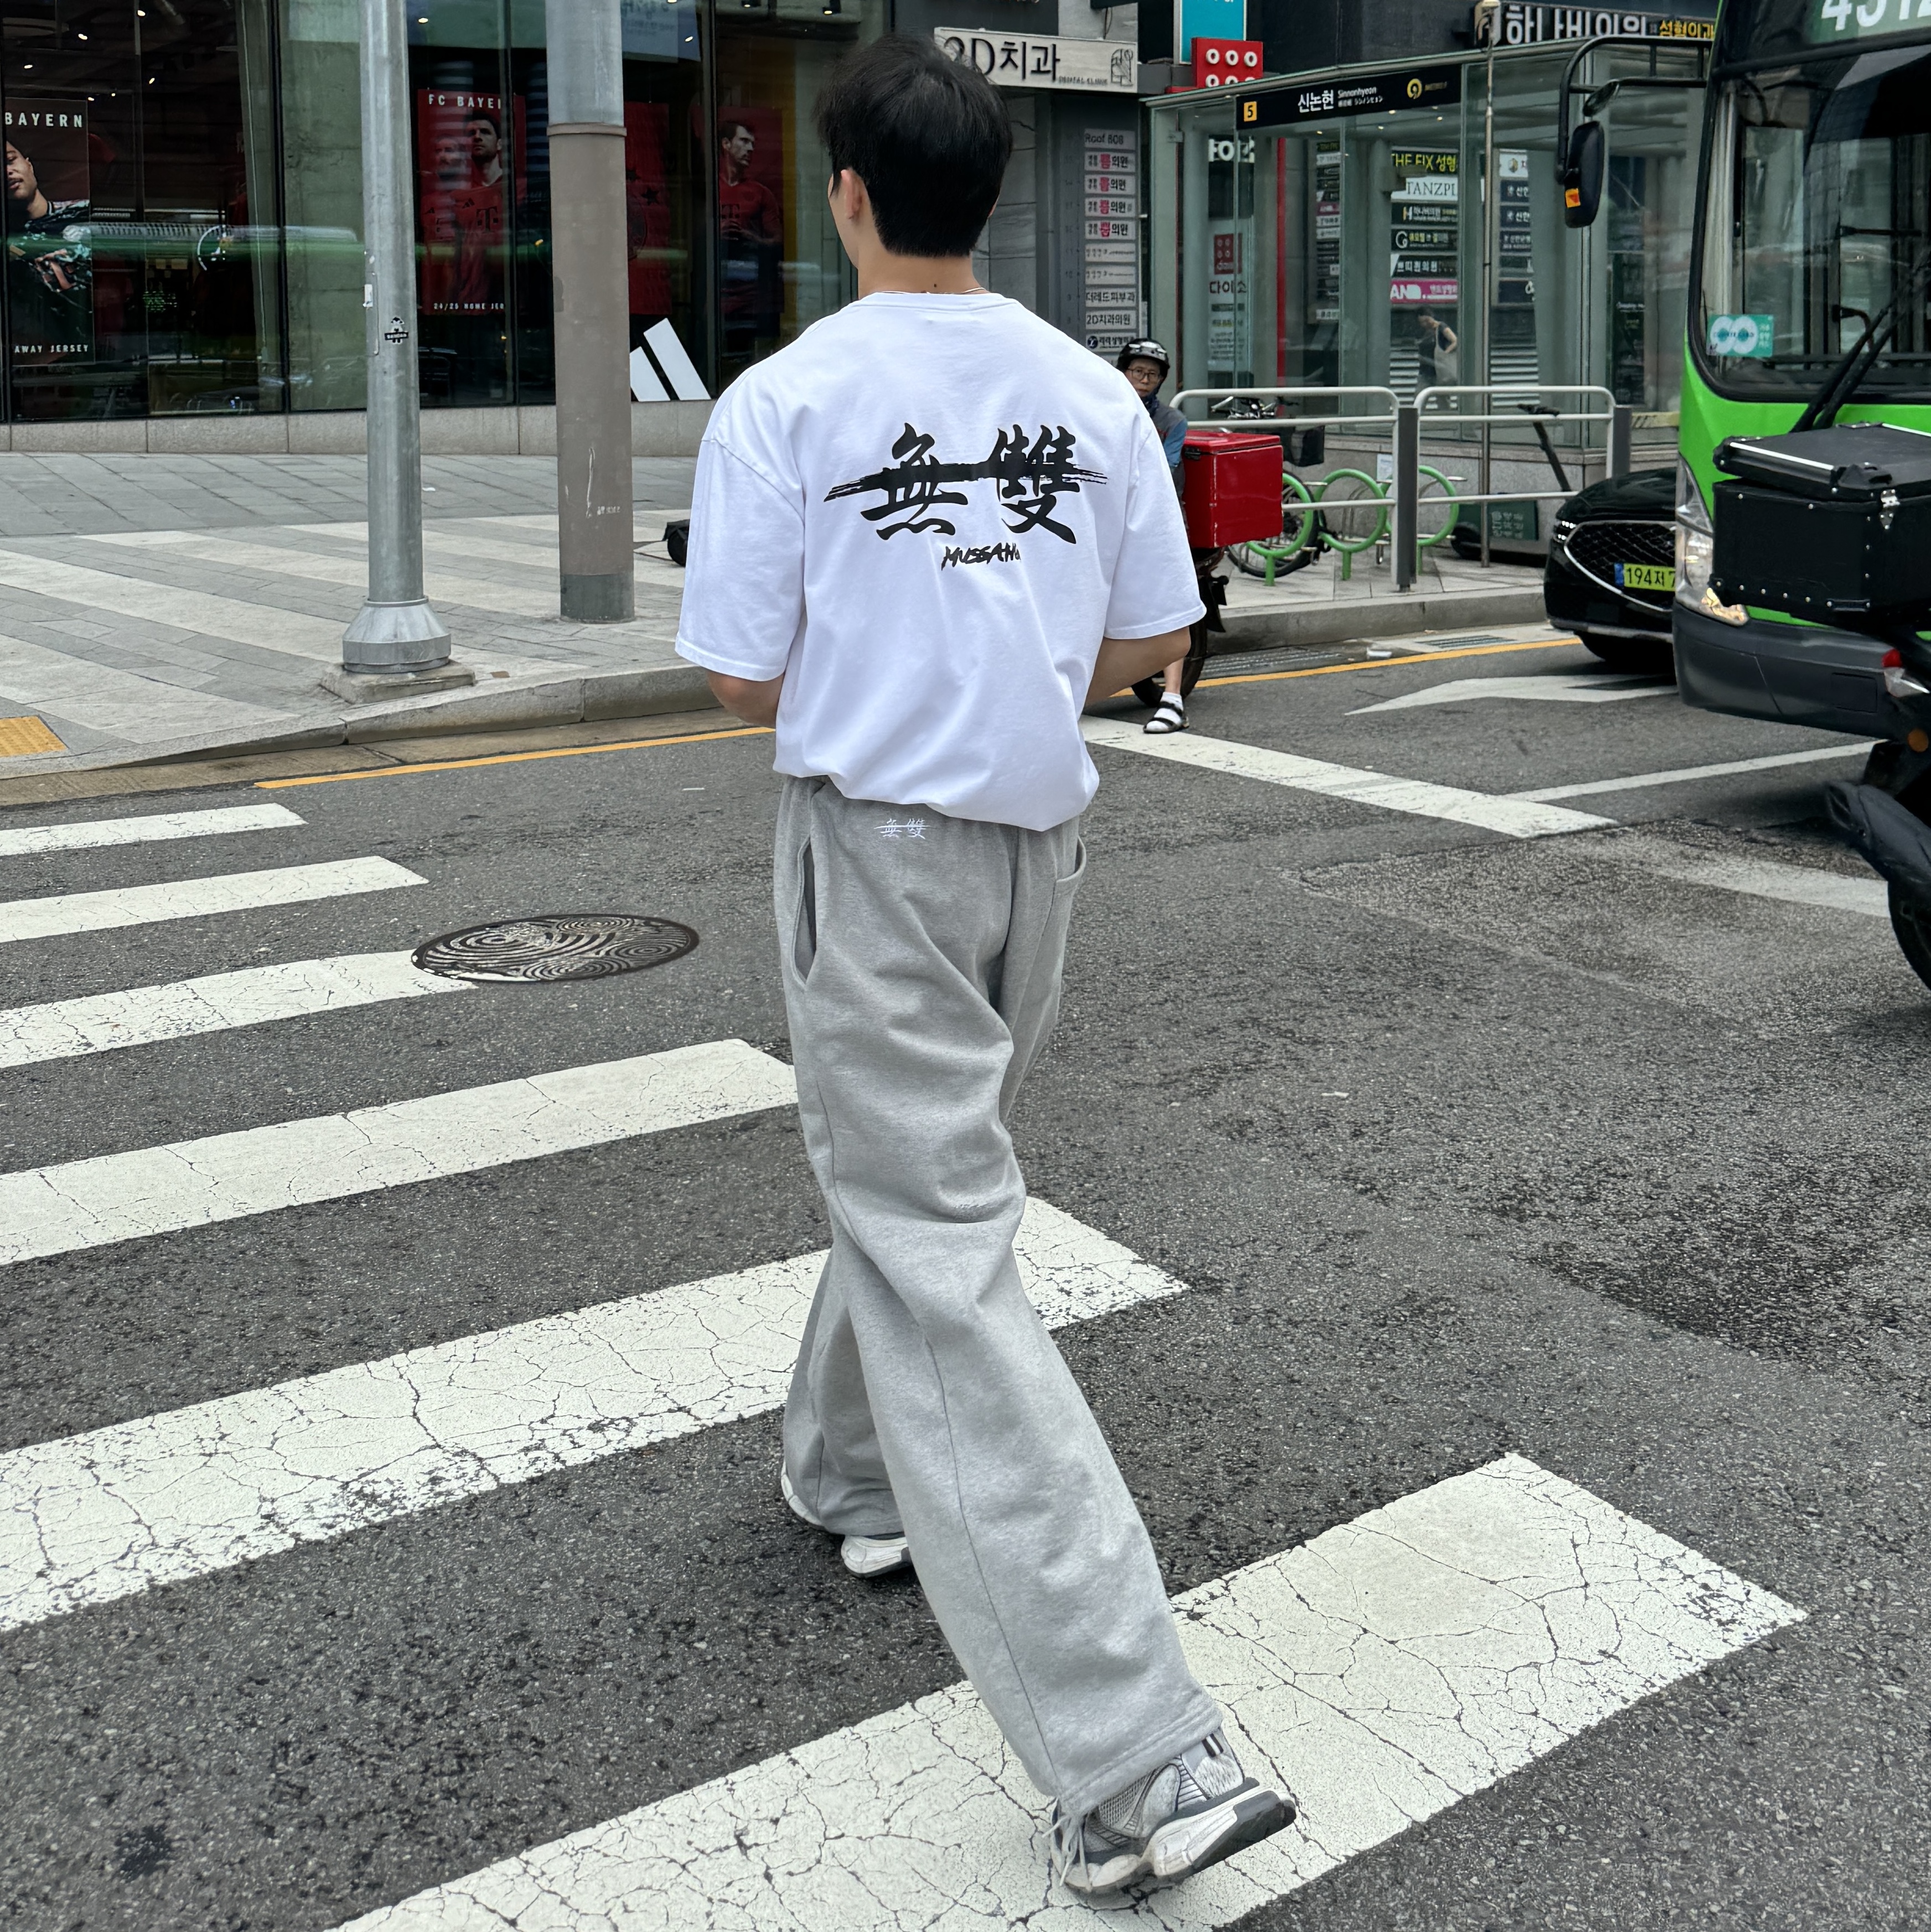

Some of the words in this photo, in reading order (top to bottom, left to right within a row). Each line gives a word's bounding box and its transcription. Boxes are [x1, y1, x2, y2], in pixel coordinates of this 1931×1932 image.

[428, 94, 445, 106] FC
[1247, 105, 1254, 118] 5
[1298, 90, 1334, 113] 신논현
[5, 112, 82, 128] BAYERN
[14, 345, 43, 353] AWAY
[50, 344, 89, 353] JERSEY
